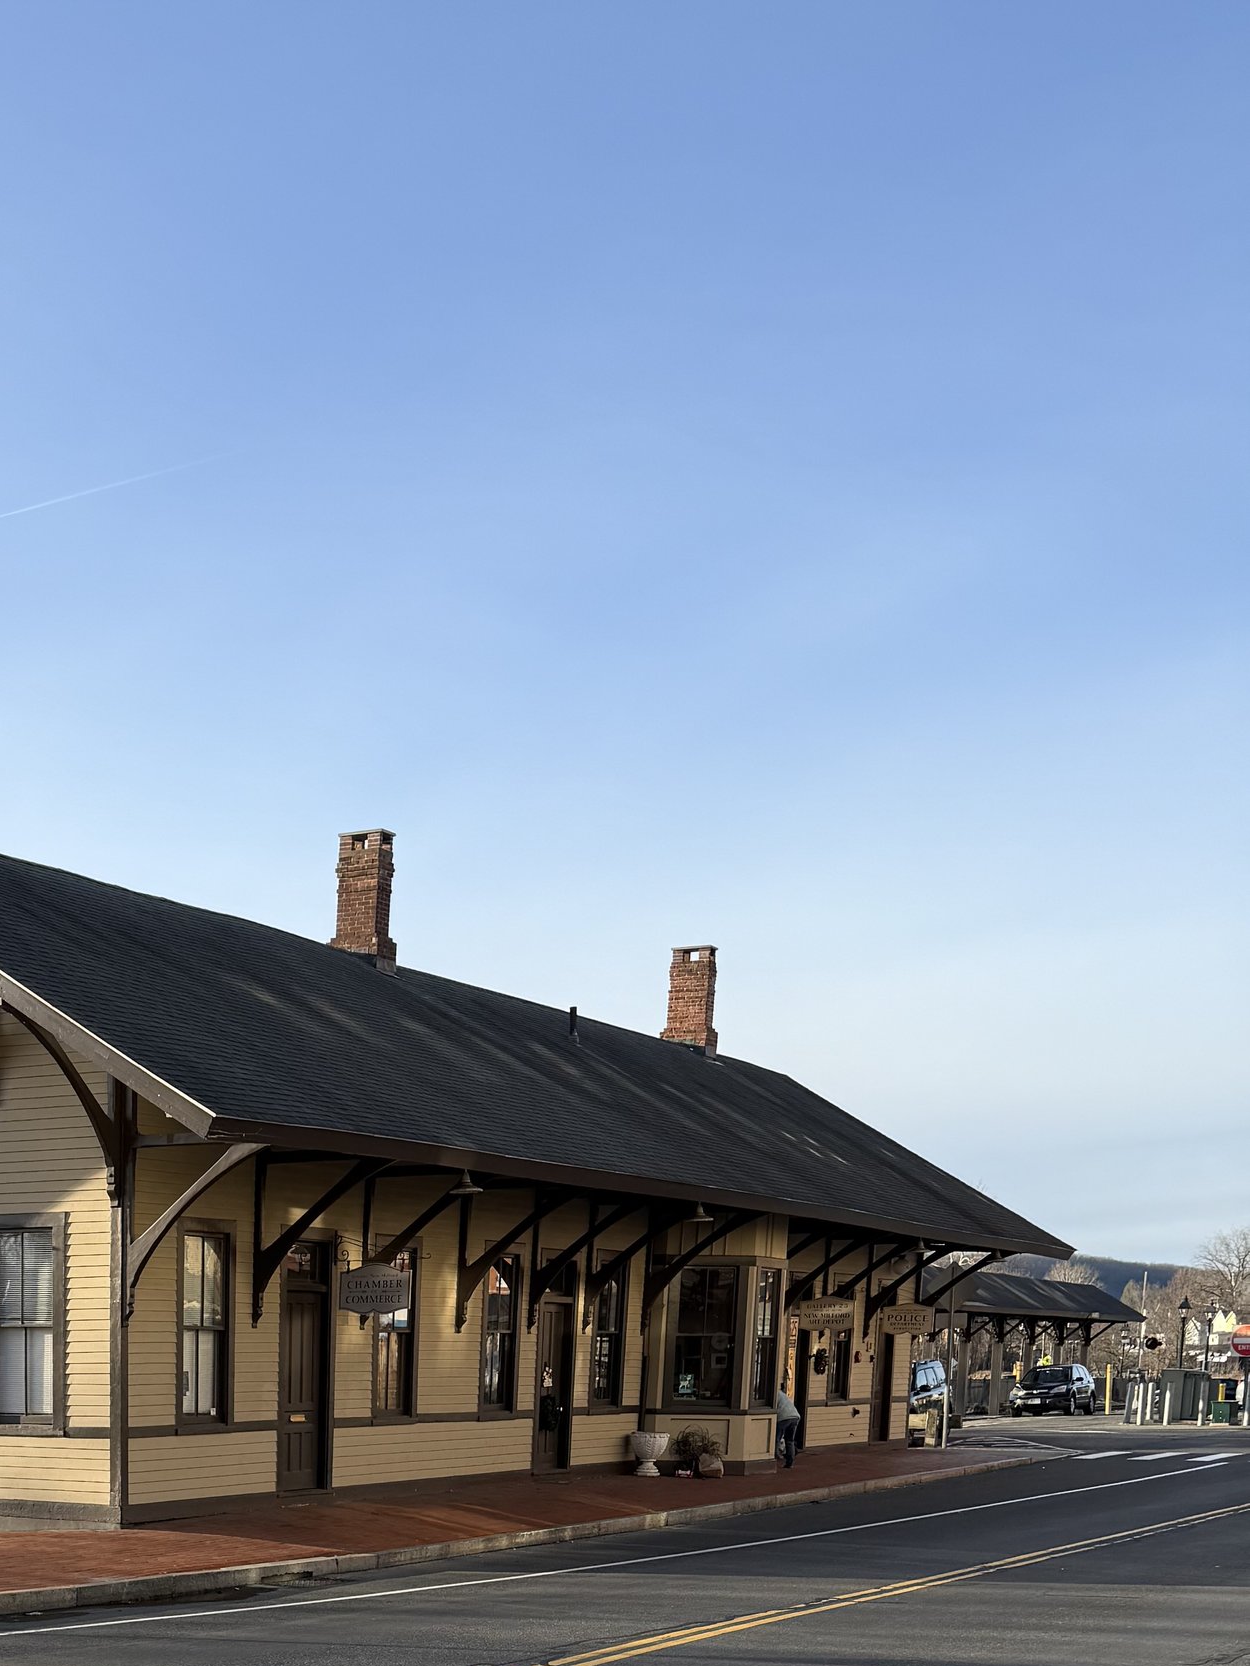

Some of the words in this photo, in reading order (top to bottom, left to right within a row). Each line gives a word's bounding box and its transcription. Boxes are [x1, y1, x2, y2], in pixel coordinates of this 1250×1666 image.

[347, 1279, 402, 1289] CHAMBER
[345, 1294, 403, 1304] COMMERCE
[887, 1314, 929, 1322] POLICE
